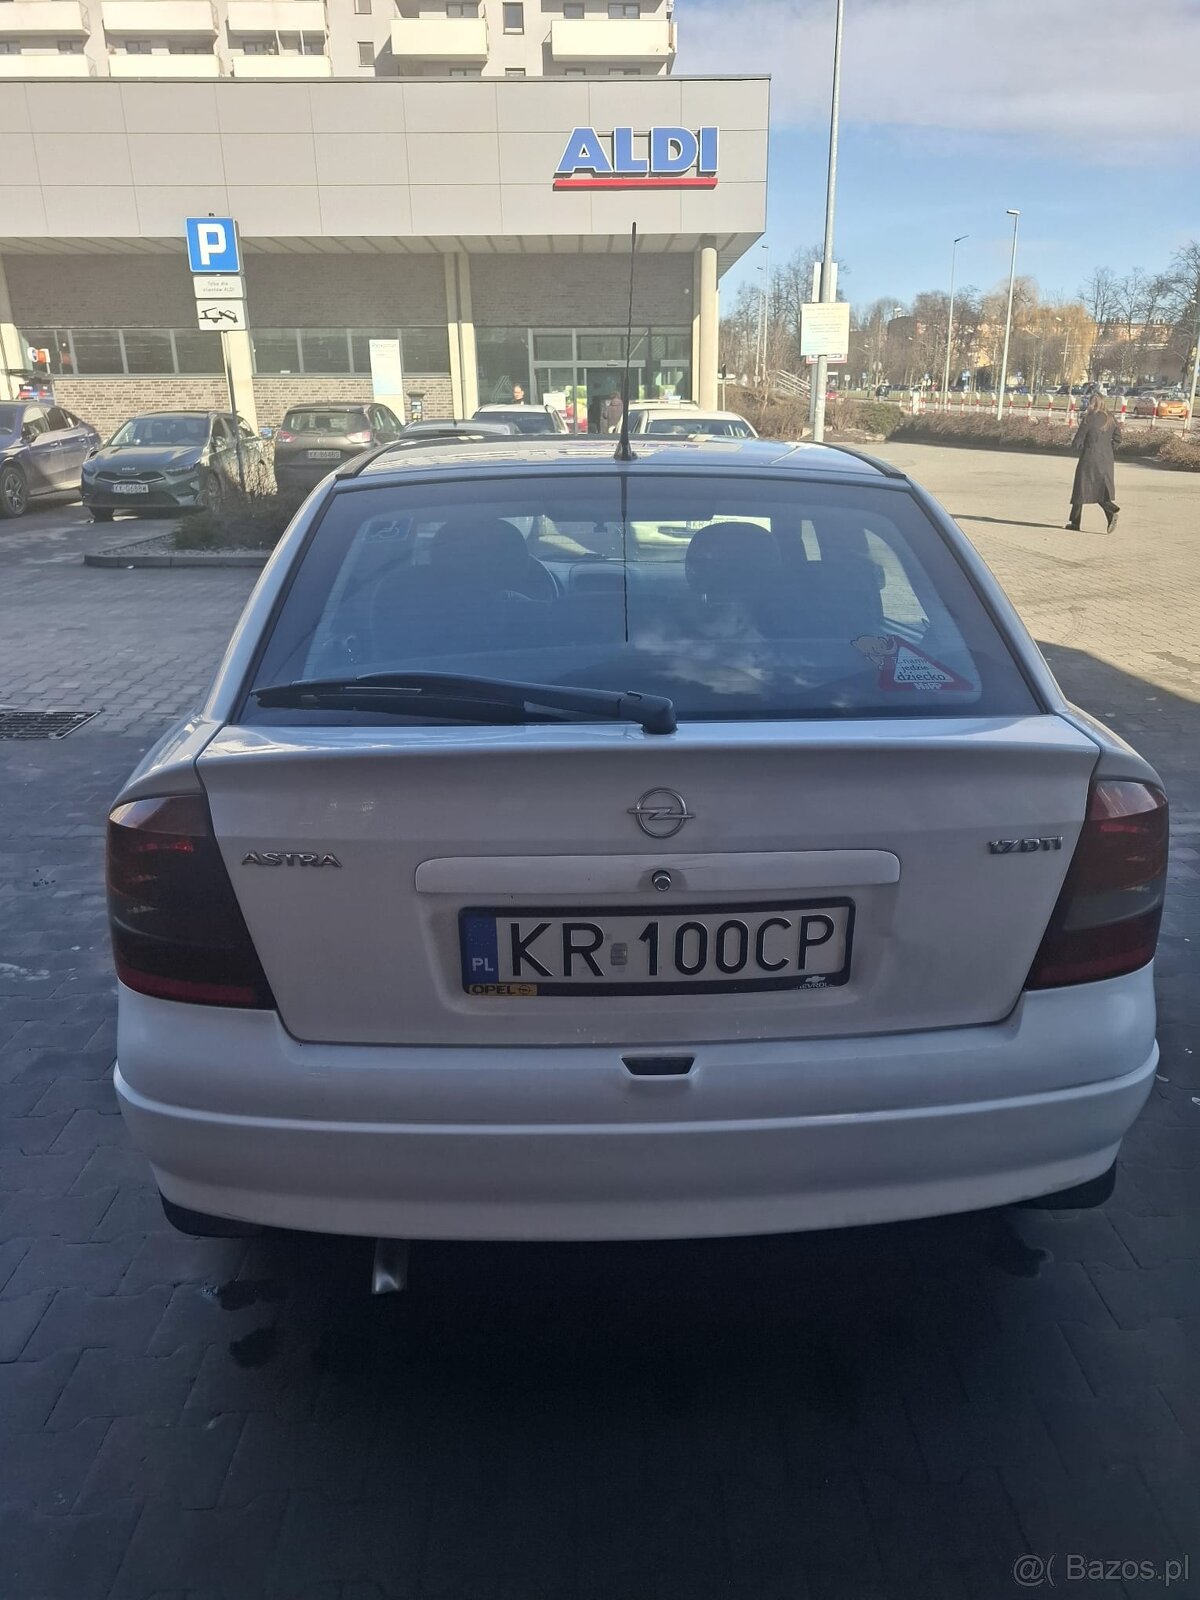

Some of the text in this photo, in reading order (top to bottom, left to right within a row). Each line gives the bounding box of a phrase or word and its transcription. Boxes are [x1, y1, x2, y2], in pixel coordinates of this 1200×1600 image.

[554, 125, 720, 176] ALDI
[197, 223, 227, 266] P
[897, 671, 946, 681] dziecko
[241, 852, 342, 868] ASTRA
[510, 914, 835, 977] KR 100CP
[472, 958, 494, 972] PL
[472, 985, 516, 996] OPEL
